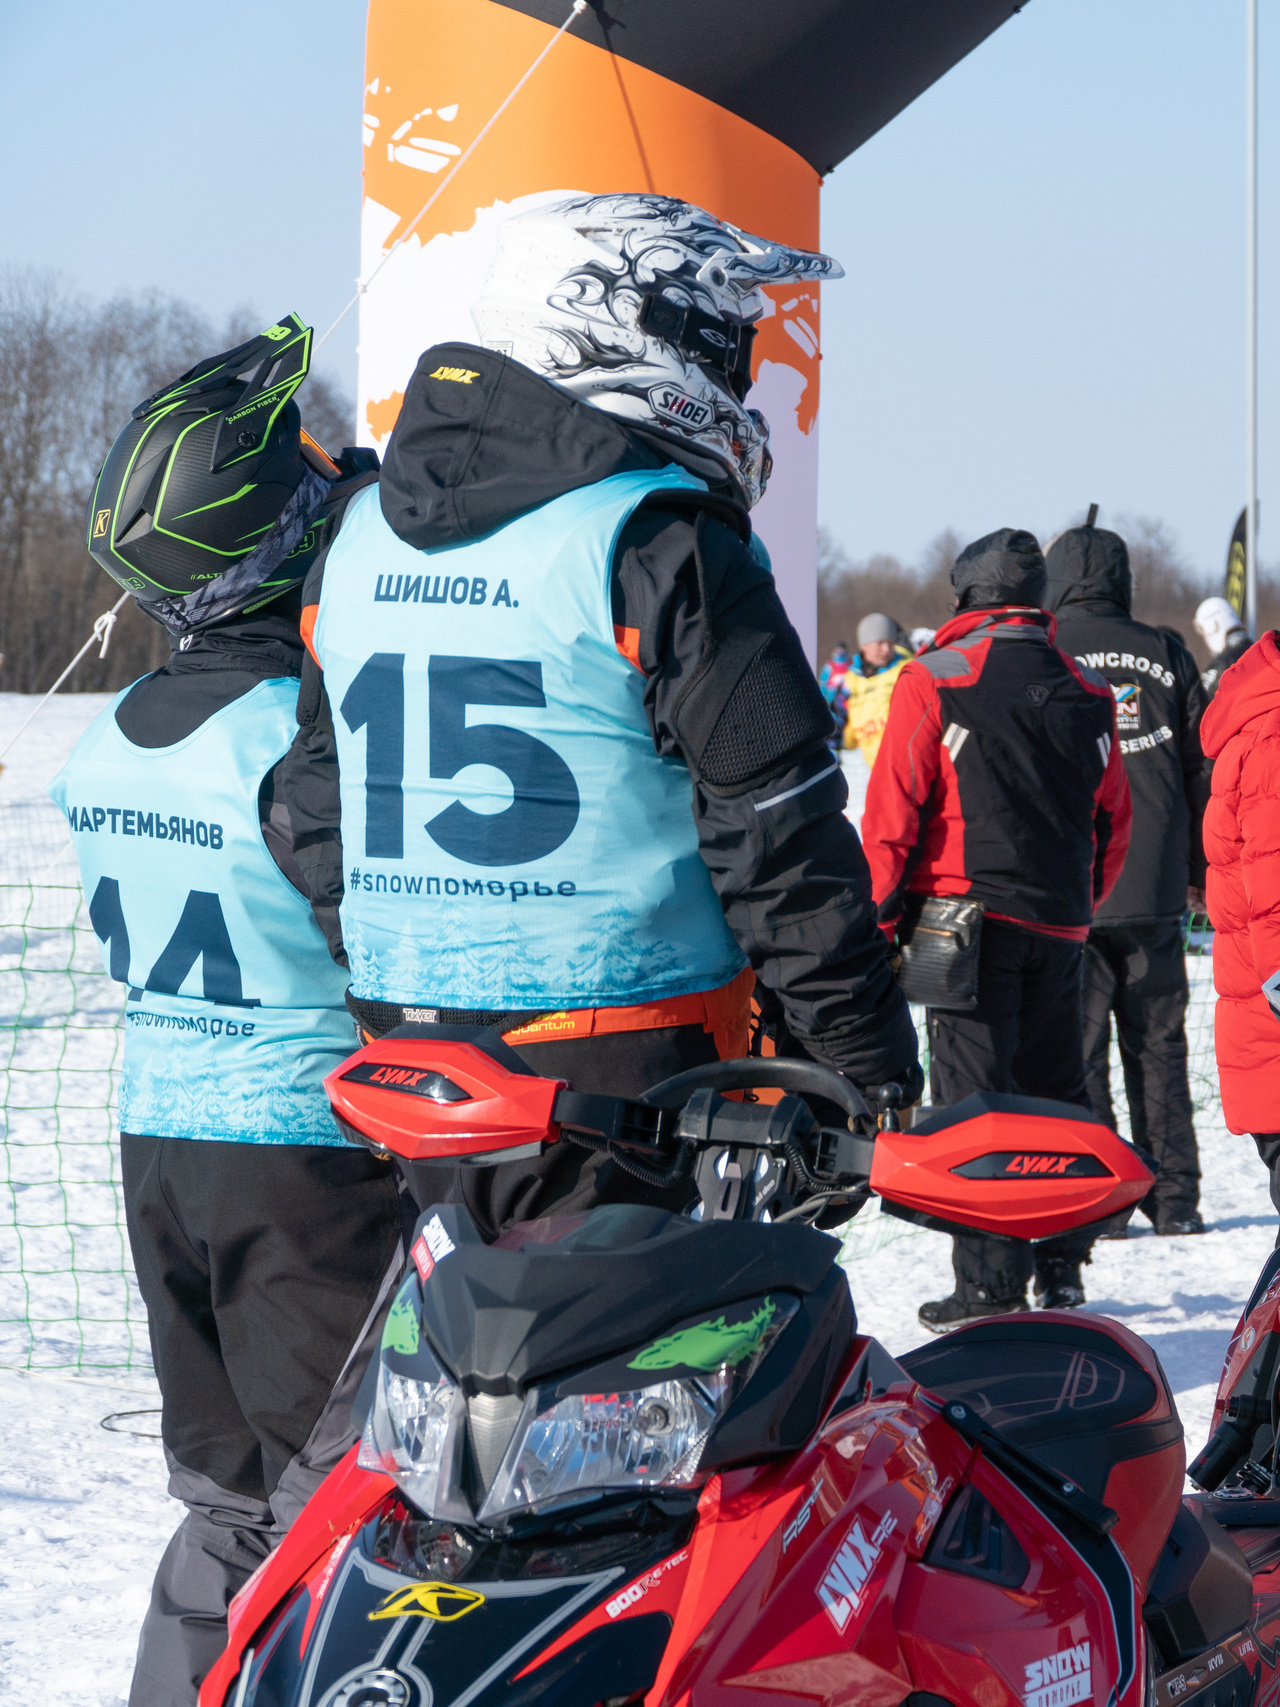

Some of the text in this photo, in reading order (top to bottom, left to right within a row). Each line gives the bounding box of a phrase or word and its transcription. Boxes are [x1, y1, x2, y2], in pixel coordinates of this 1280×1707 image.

[429, 366, 481, 384] LYNX
[227, 395, 278, 424] CARBON FIBER
[658, 390, 707, 425] SHOEI
[374, 574, 488, 605] ШИШОВ
[1120, 725, 1173, 754] SERIES
[339, 652, 580, 867] 15
[67, 806, 223, 850] МАРТЕМЬЯНОВ
[350, 867, 577, 902] #snowпоморье
[89, 876, 261, 1009] 14
[368, 1067, 428, 1087] LYNX
[1005, 1155, 1078, 1175] LYNX
[605, 1550, 689, 1619] 800R E-TEC
[818, 1521, 881, 1629] LYNX
[1024, 1641, 1090, 1692] SNOW
